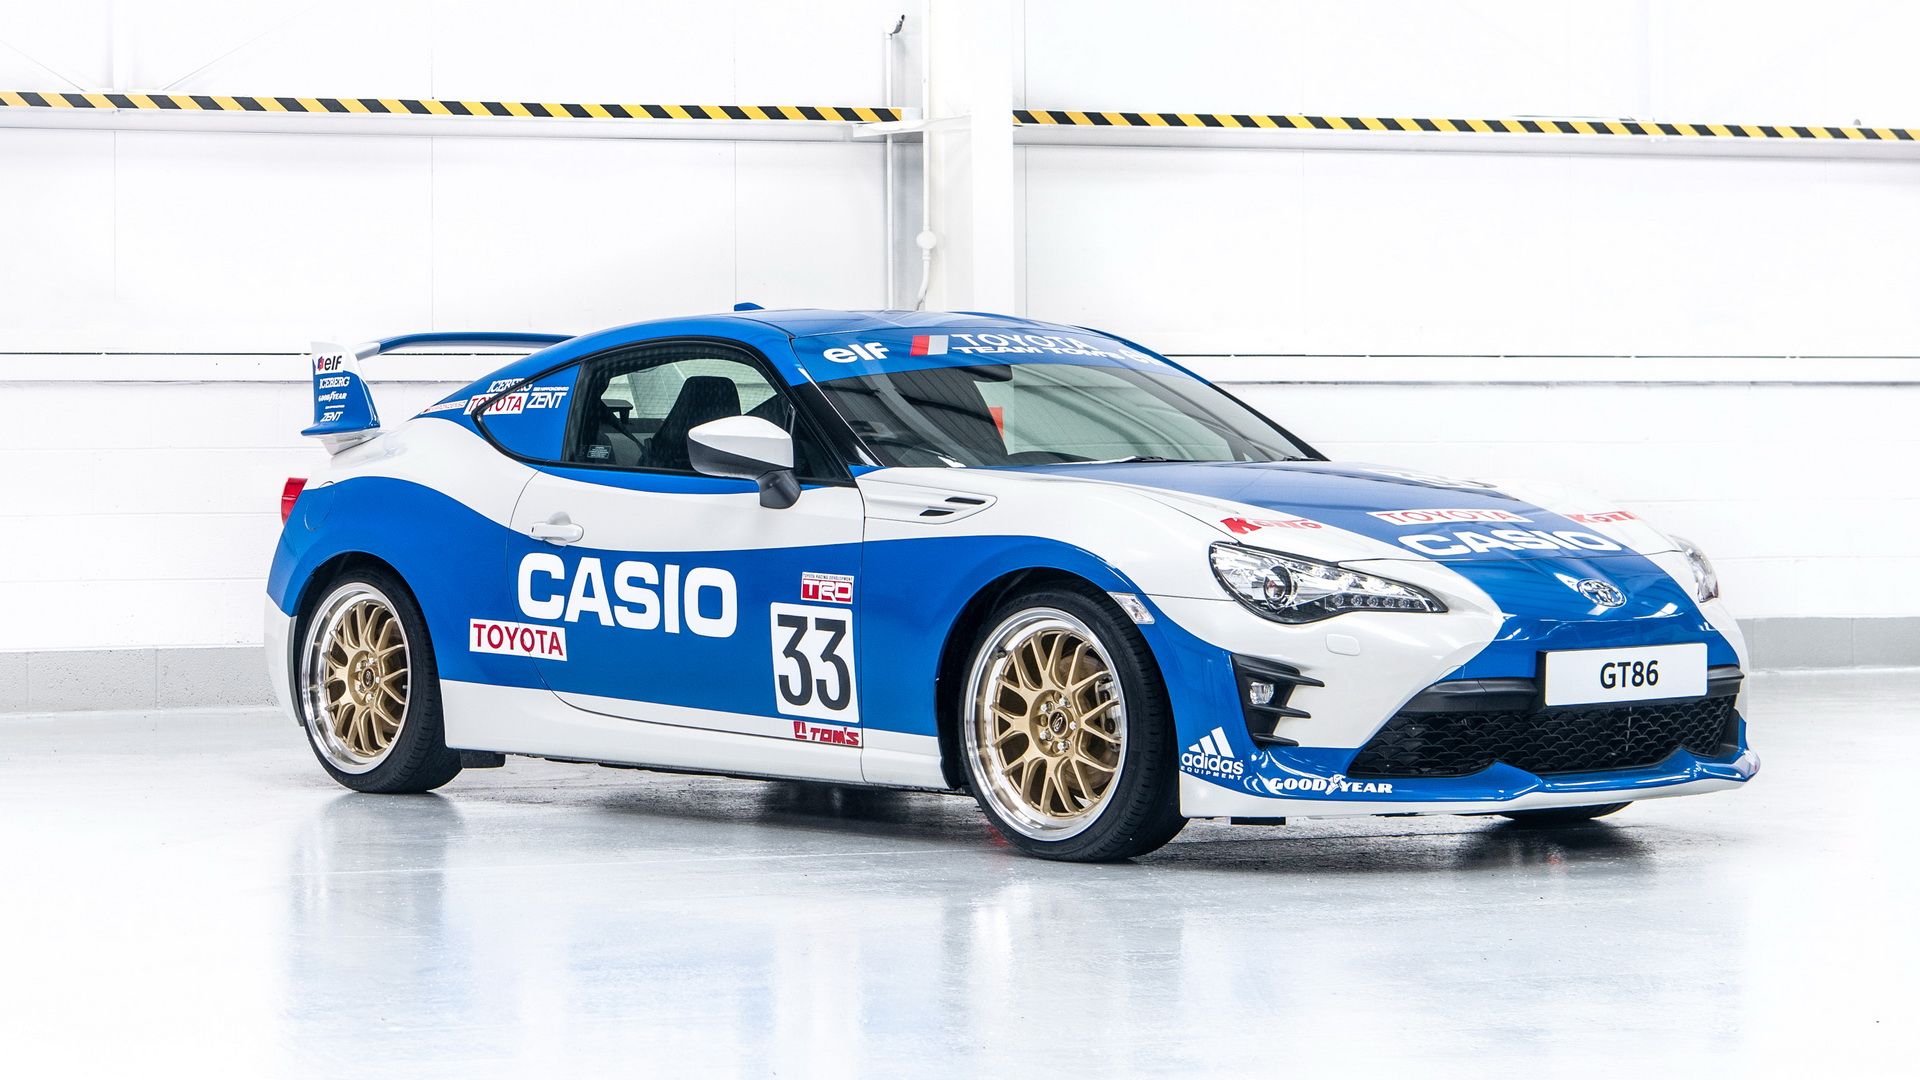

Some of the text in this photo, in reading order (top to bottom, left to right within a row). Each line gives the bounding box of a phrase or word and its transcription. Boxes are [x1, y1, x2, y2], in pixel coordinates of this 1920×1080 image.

[951, 333, 1100, 352] TOYOTA
[952, 346, 1044, 354] TEAM
[823, 342, 890, 364] elf
[324, 355, 343, 371] elf
[319, 376, 351, 389] ICEBERG
[486, 378, 534, 393] ICEBG
[526, 391, 568, 409] ZENT
[320, 411, 344, 423] ZENT
[1375, 510, 1524, 523] TOYOTA
[1398, 529, 1622, 556] CASIO
[517, 552, 739, 638] CASIO
[803, 580, 853, 602] TRD
[472, 623, 565, 657] TOYOTA
[777, 613, 852, 711] 33
[1600, 660, 1659, 689] GT86
[810, 727, 860, 746] TOM'S
[1180, 765, 1242, 781] EQUIPMENT
[1181, 752, 1244, 775] adidas
